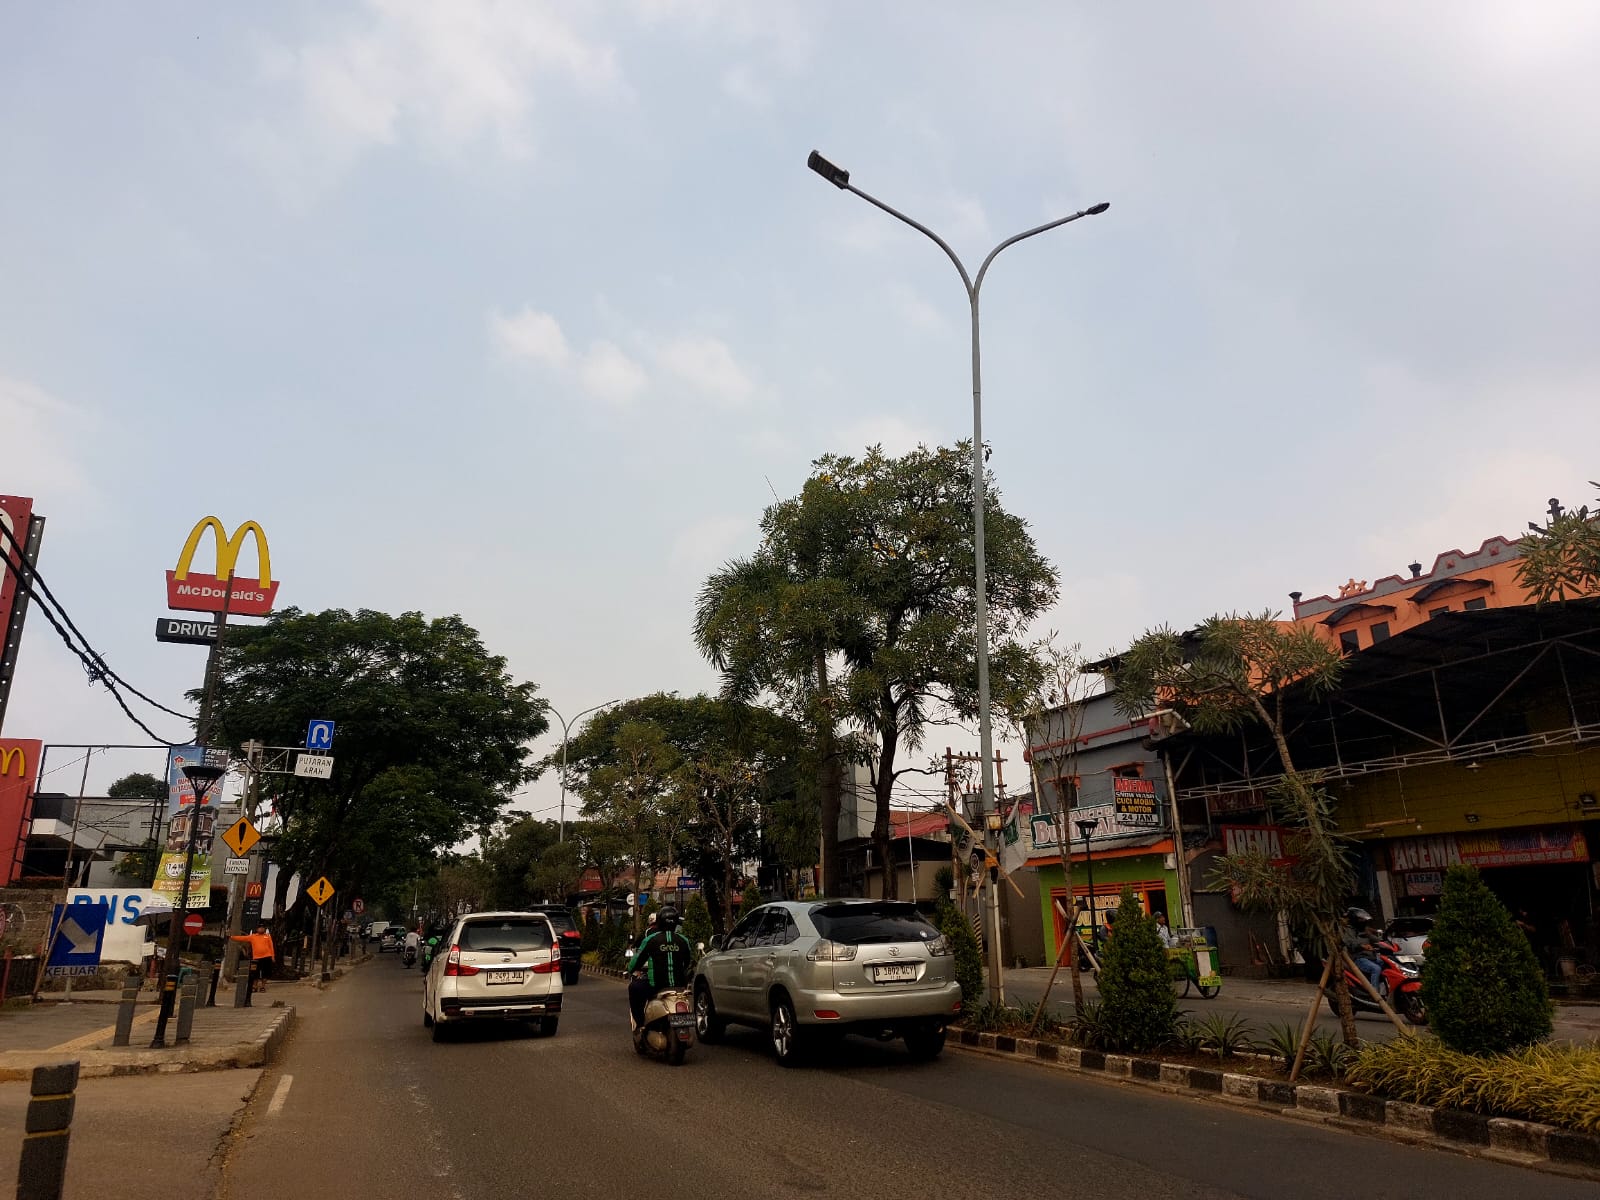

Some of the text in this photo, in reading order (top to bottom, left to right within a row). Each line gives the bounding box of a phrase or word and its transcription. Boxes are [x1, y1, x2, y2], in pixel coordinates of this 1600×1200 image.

[167, 621, 219, 637] DRIVE
[299, 757, 332, 767] PUTARAN
[303, 766, 324, 775] ARAH
[1133, 798, 1156, 806] MOBIL
[1128, 805, 1152, 813] MOTOR
[1136, 814, 1154, 822] JAM
[1225, 828, 1283, 860] AREMA
[1393, 836, 1463, 871] AREMA
[659, 944, 680, 952] Grab
[45, 966, 96, 977] KELUAR
